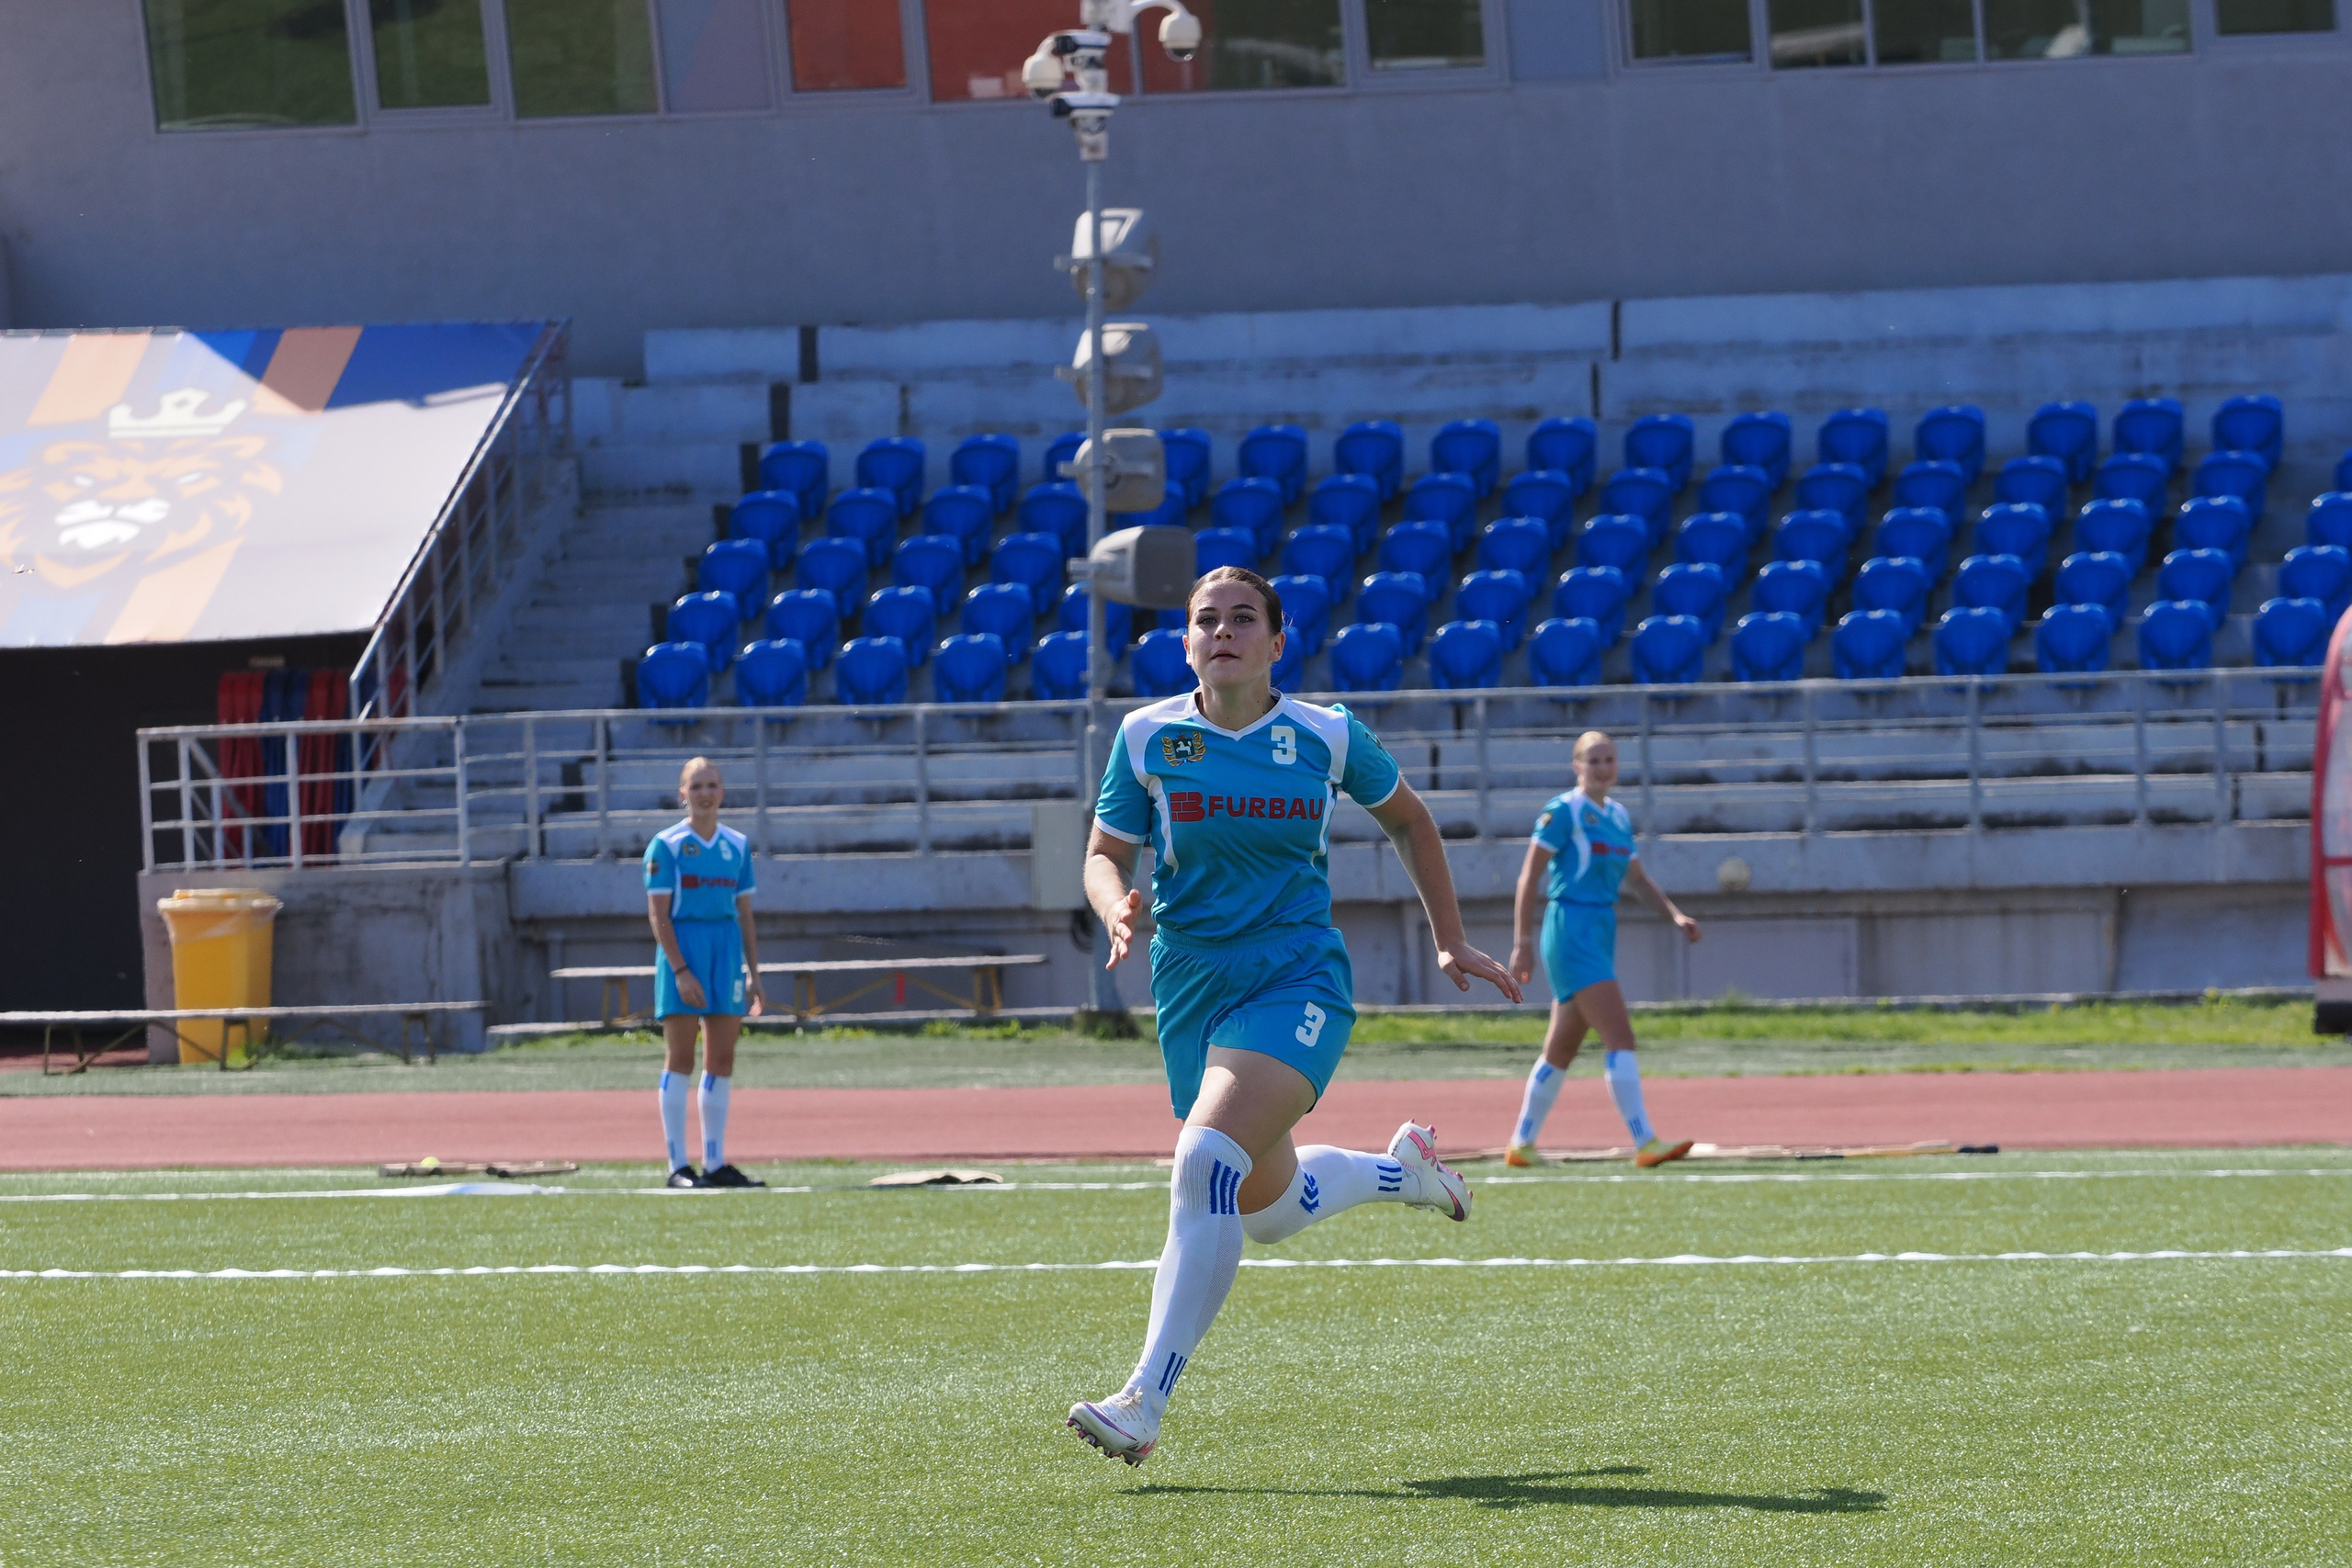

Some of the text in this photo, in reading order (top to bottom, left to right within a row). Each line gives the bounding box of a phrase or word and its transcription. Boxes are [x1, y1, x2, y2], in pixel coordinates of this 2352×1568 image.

[1271, 725, 1297, 765] 3
[1208, 795, 1324, 821] FURBAU
[1295, 1000, 1326, 1047] 3
